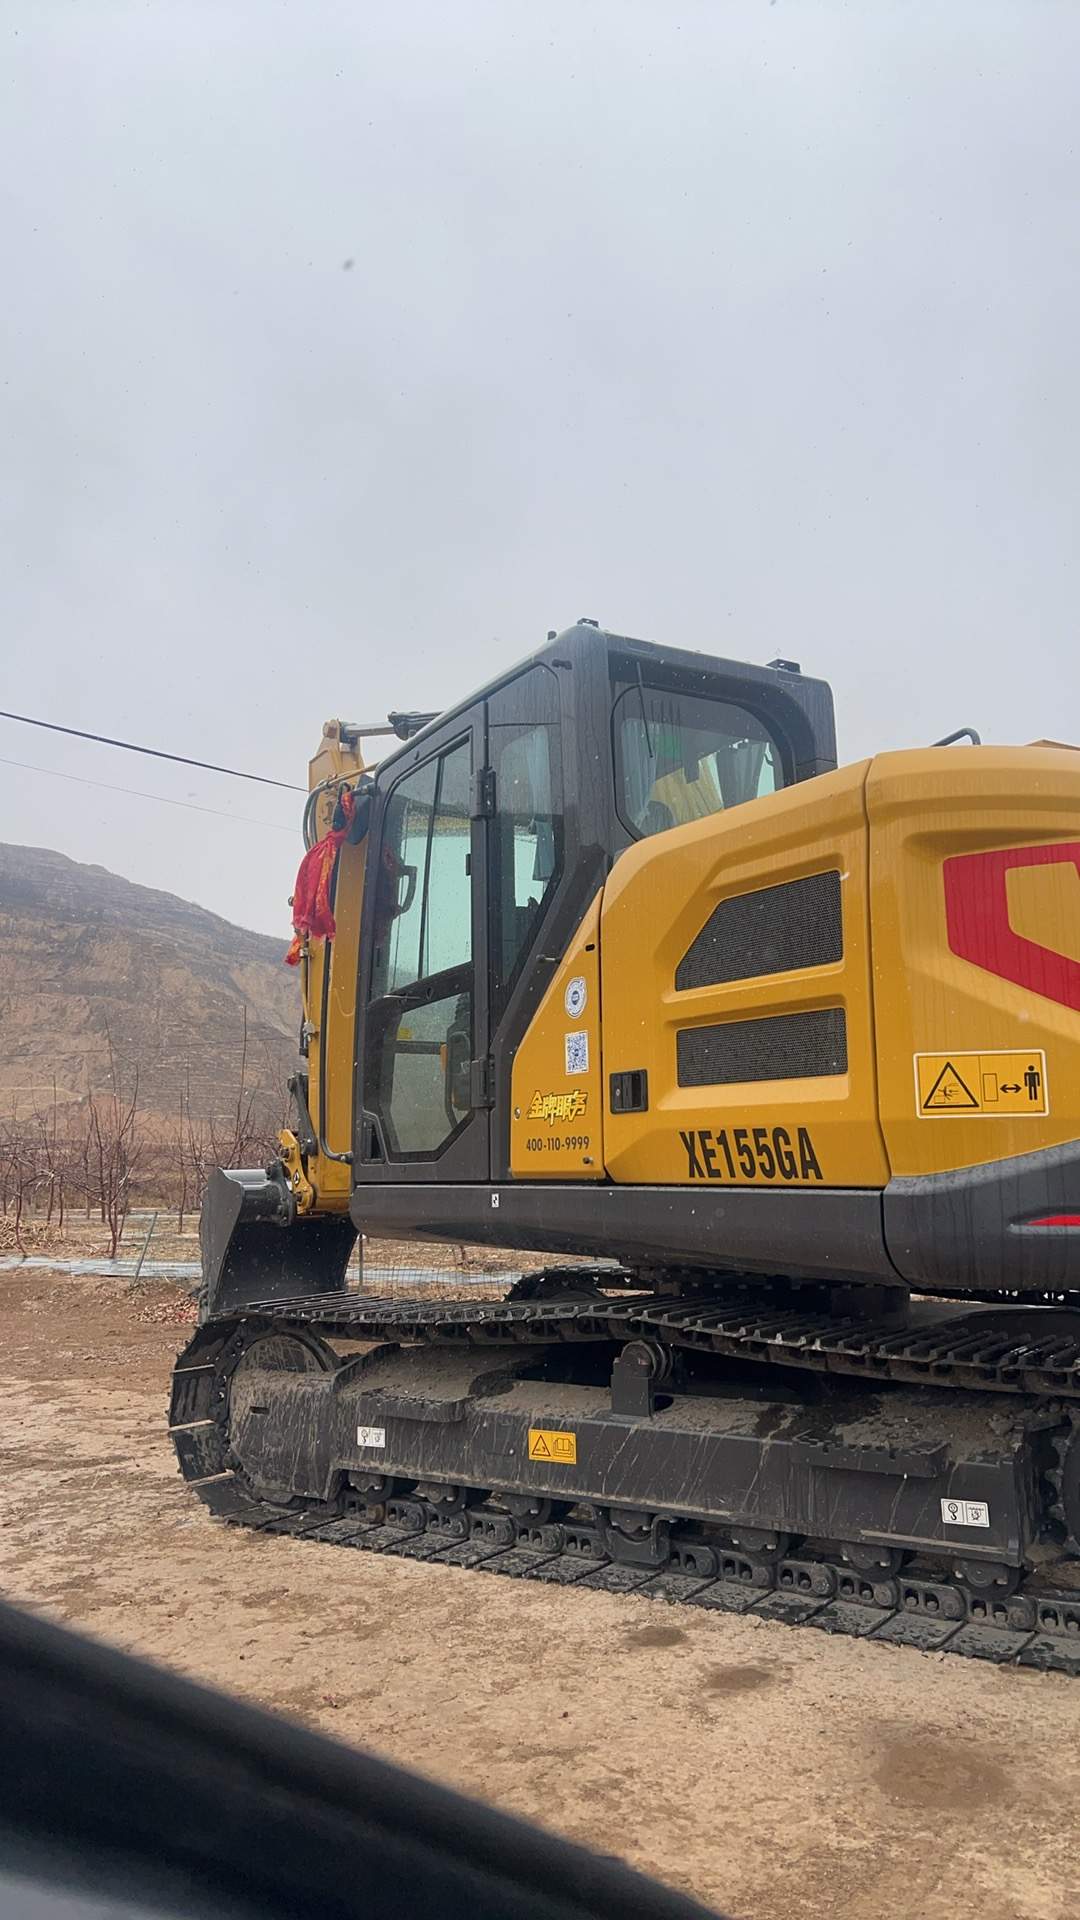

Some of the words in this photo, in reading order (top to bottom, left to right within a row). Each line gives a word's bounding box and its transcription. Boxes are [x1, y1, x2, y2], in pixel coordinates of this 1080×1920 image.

[527, 1089, 588, 1127] 金牌服务
[527, 1136, 590, 1152] 400-110-9999
[679, 1127, 823, 1180] XE155GA
